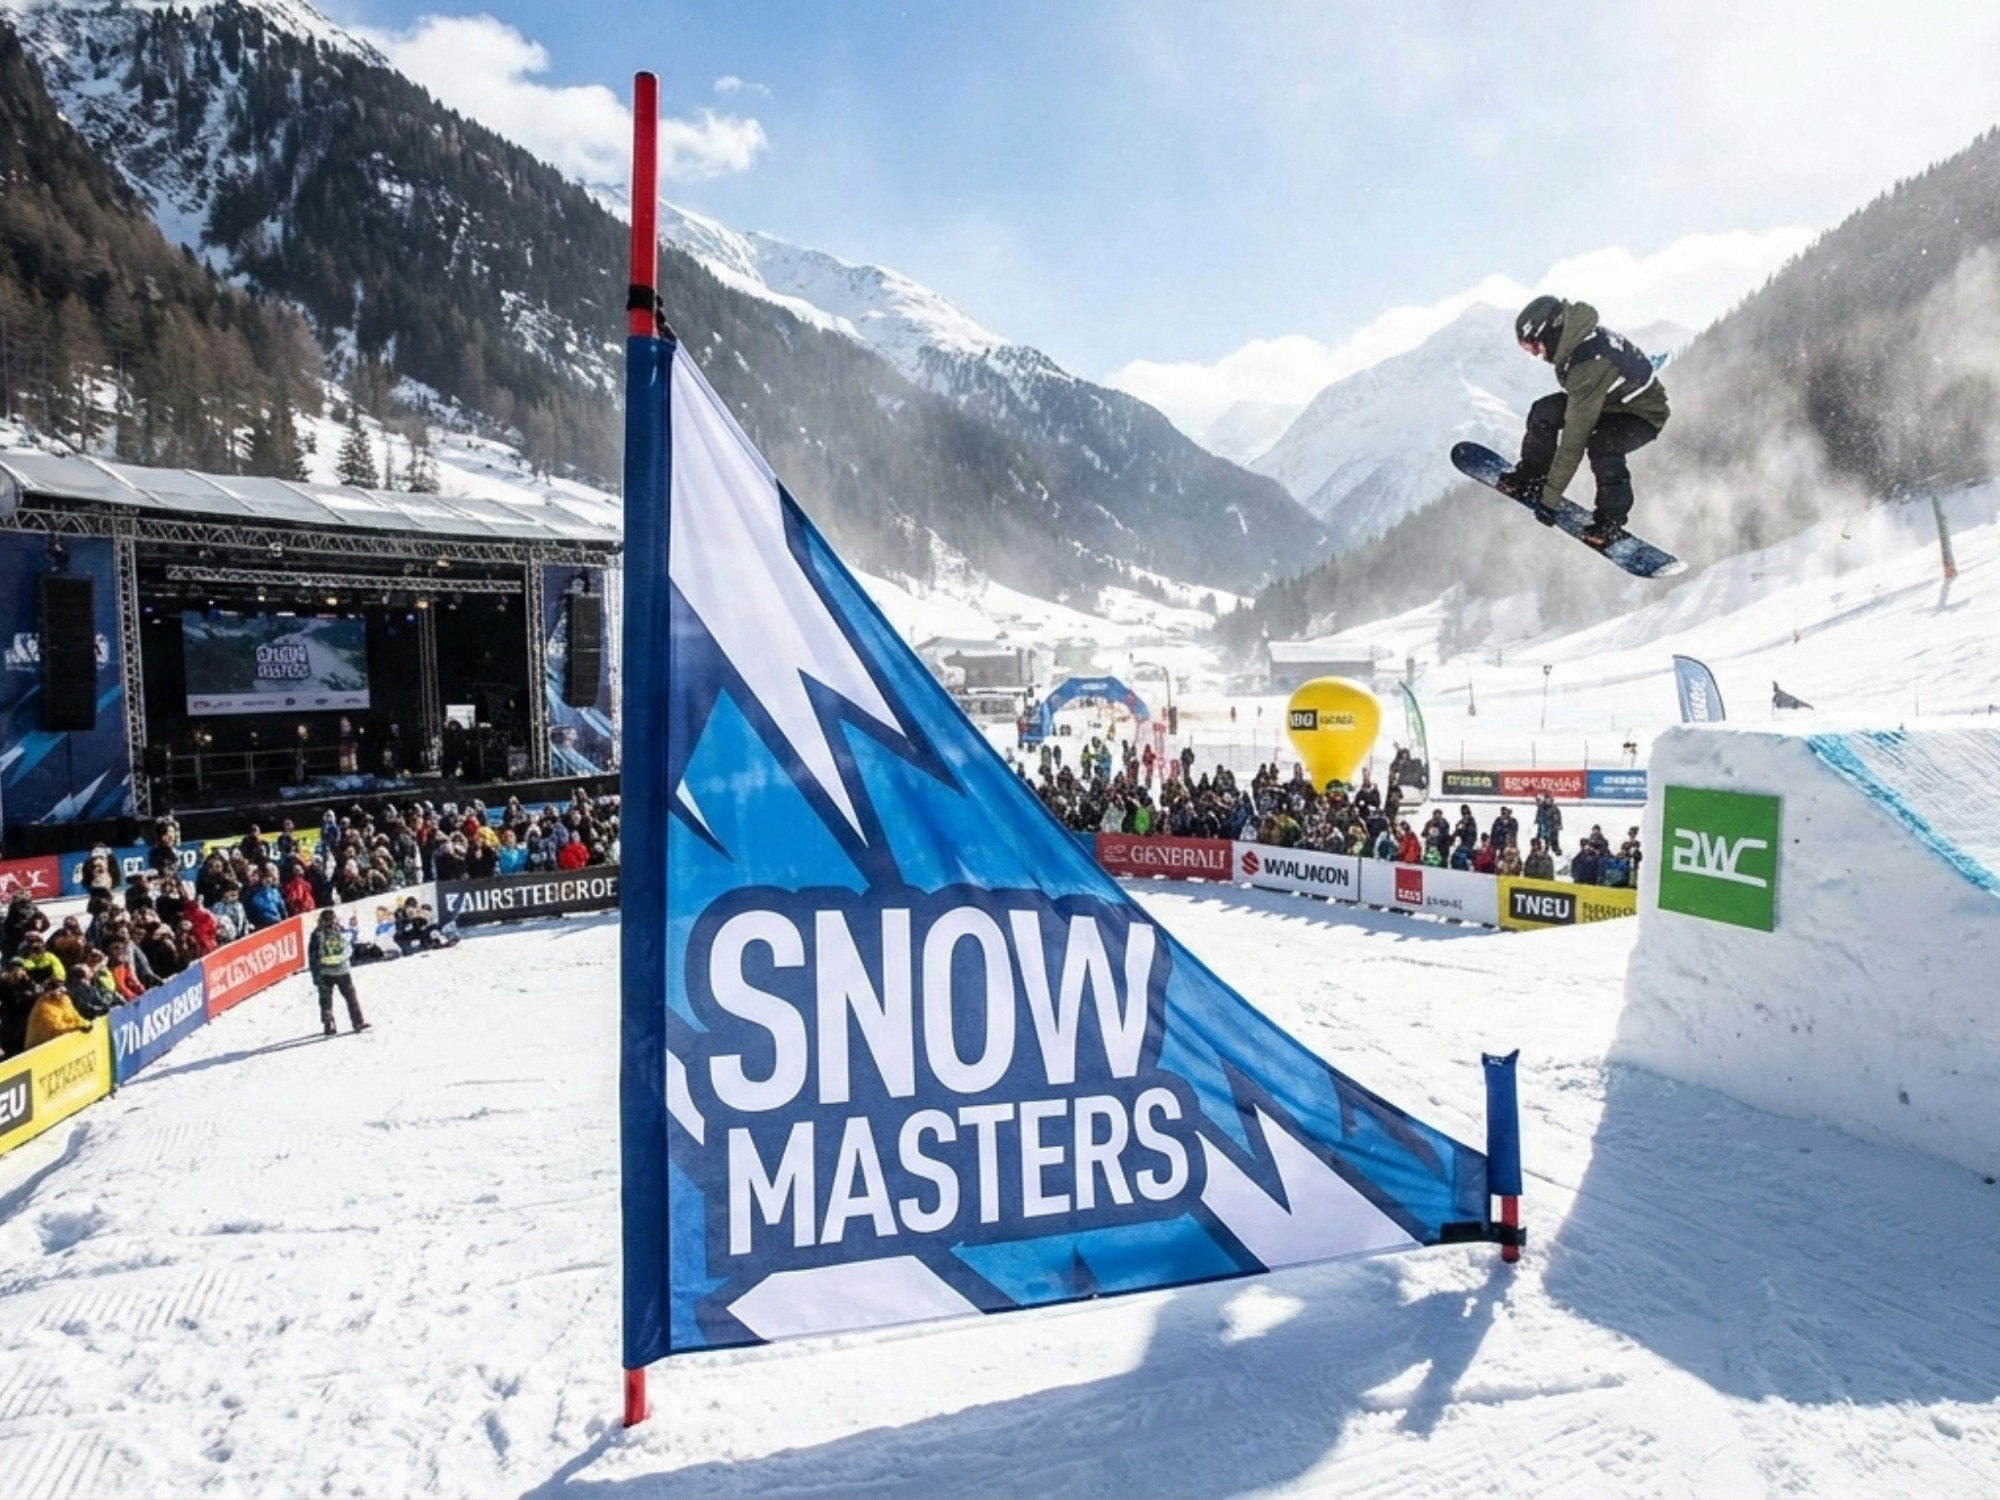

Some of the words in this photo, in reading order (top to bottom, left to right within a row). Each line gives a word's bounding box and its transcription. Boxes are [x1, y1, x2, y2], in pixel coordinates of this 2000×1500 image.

[1514, 892, 1570, 920] TNEU
[708, 905, 1157, 1112] SNOW
[727, 1086, 1190, 1256] MASTERS
